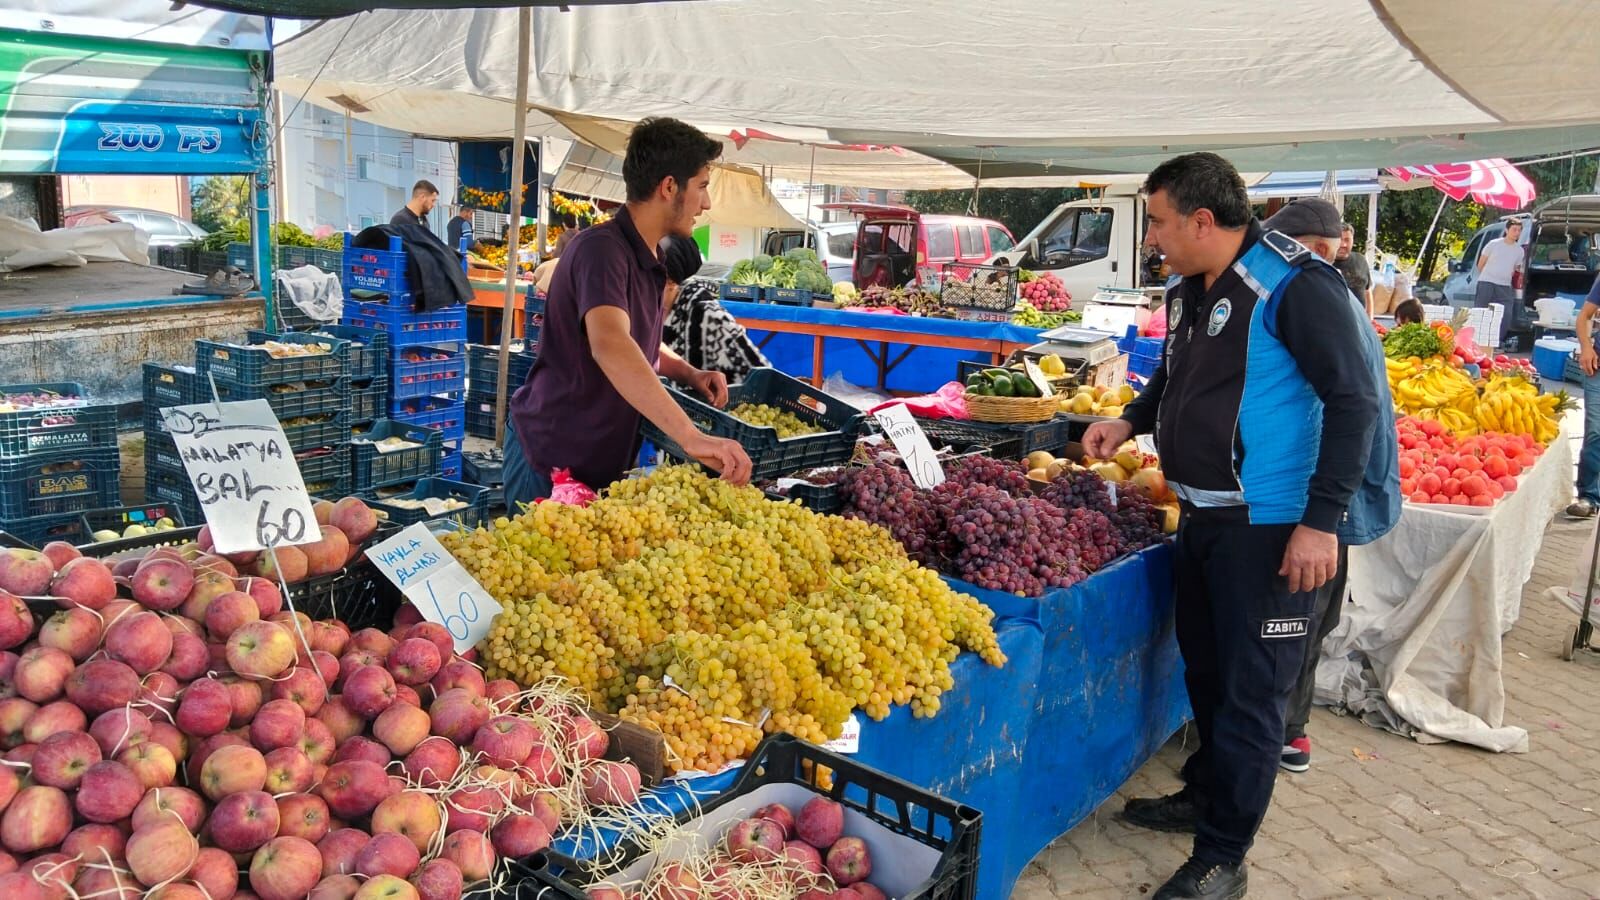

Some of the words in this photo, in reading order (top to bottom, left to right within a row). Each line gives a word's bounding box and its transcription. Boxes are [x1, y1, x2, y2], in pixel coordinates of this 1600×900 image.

[98, 122, 164, 152] 200
[176, 125, 221, 153] PS
[182, 439, 282, 464] MALATYA
[256, 500, 306, 547] 60
[377, 539, 422, 568] YAYLA
[426, 579, 478, 641] 60
[1266, 621, 1304, 633] ZABITA
